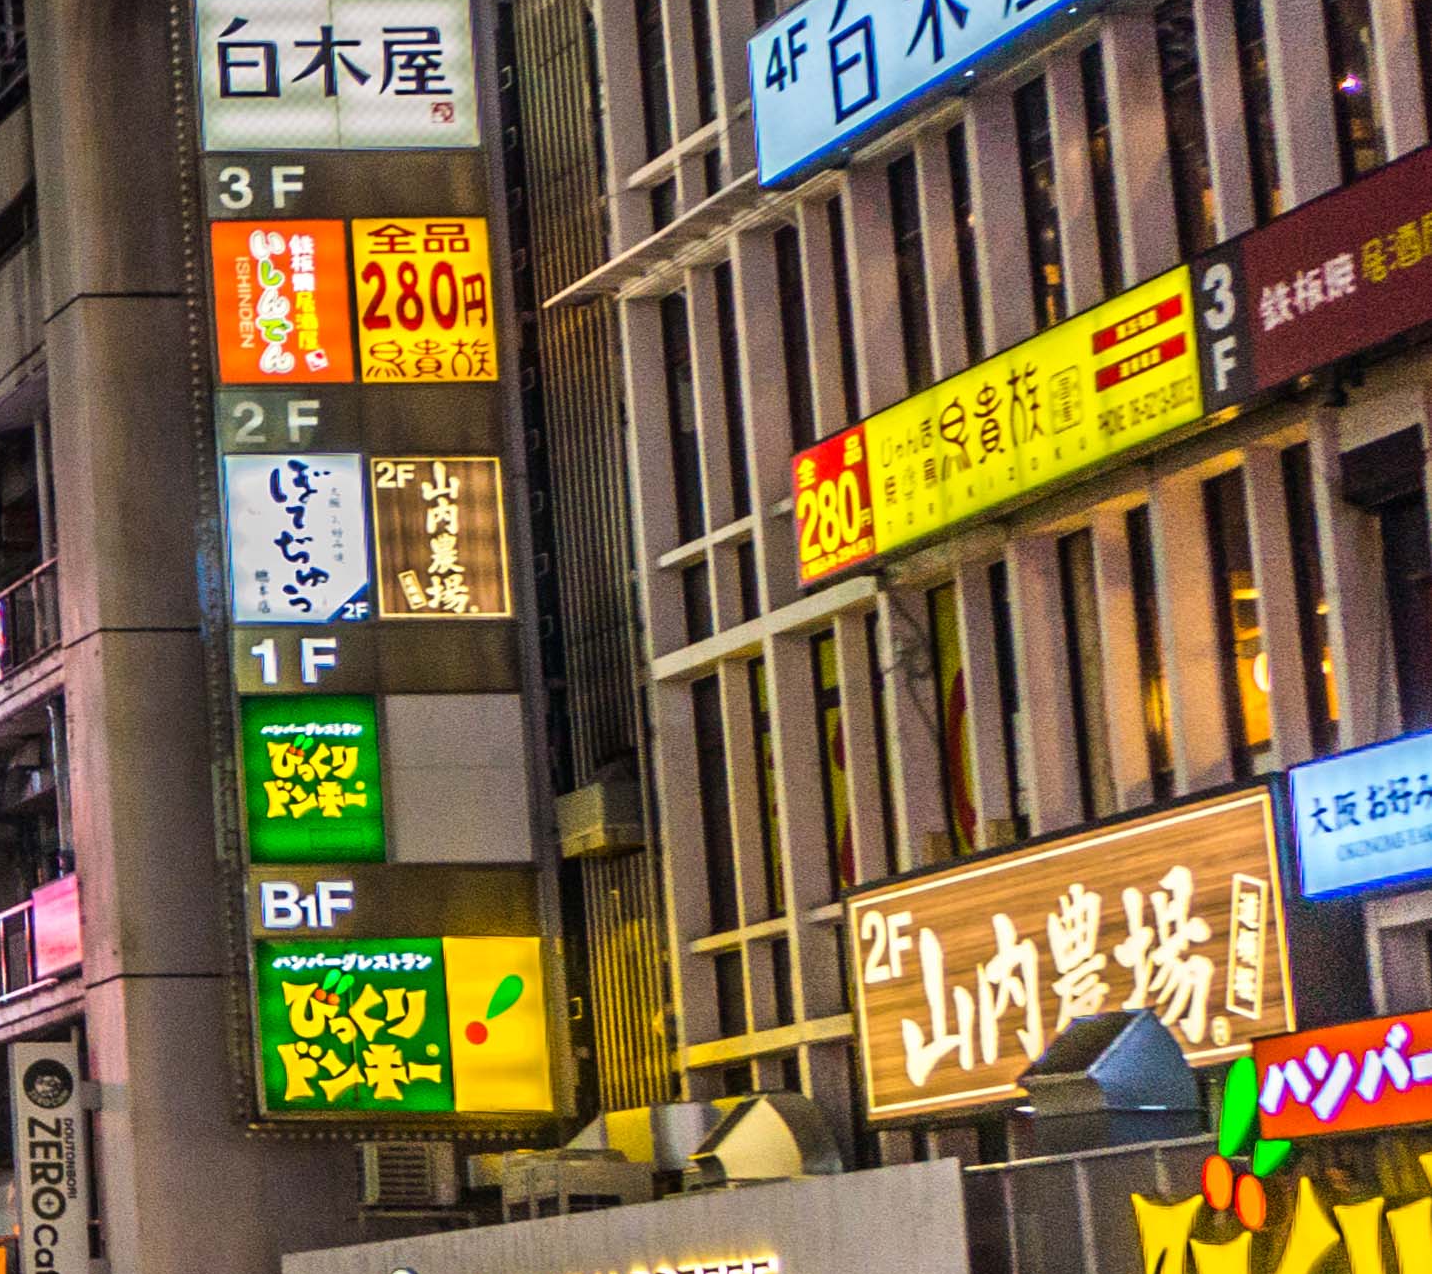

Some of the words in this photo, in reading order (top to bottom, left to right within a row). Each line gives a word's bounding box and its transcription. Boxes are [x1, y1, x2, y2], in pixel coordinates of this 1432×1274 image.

[216, 15, 455, 101] 白木屋
[765, 17, 809, 93] 4F
[367, 222, 471, 255] 全品
[235, 254, 256, 351] ISHINDEN
[249, 228, 296, 375] いしんでん
[360, 259, 489, 333] 280円
[375, 463, 416, 490] 2F
[421, 459, 474, 613] 山内農場
[340, 602, 371, 621] 2F
[259, 721, 364, 738] ハンバーグレストラン
[265, 737, 360, 783] びっくり
[263, 779, 369, 820] ドンキー
[259, 878, 357, 930] B1F
[271, 951, 433, 973] ハンバーグレストラン
[858, 909, 914, 985] 2F
[898, 864, 1215, 1089] 山内農場
[280, 979, 429, 1046] びっくり
[277, 1040, 444, 1103] ドンキー
[27, 1115, 68, 1221] ZERO
